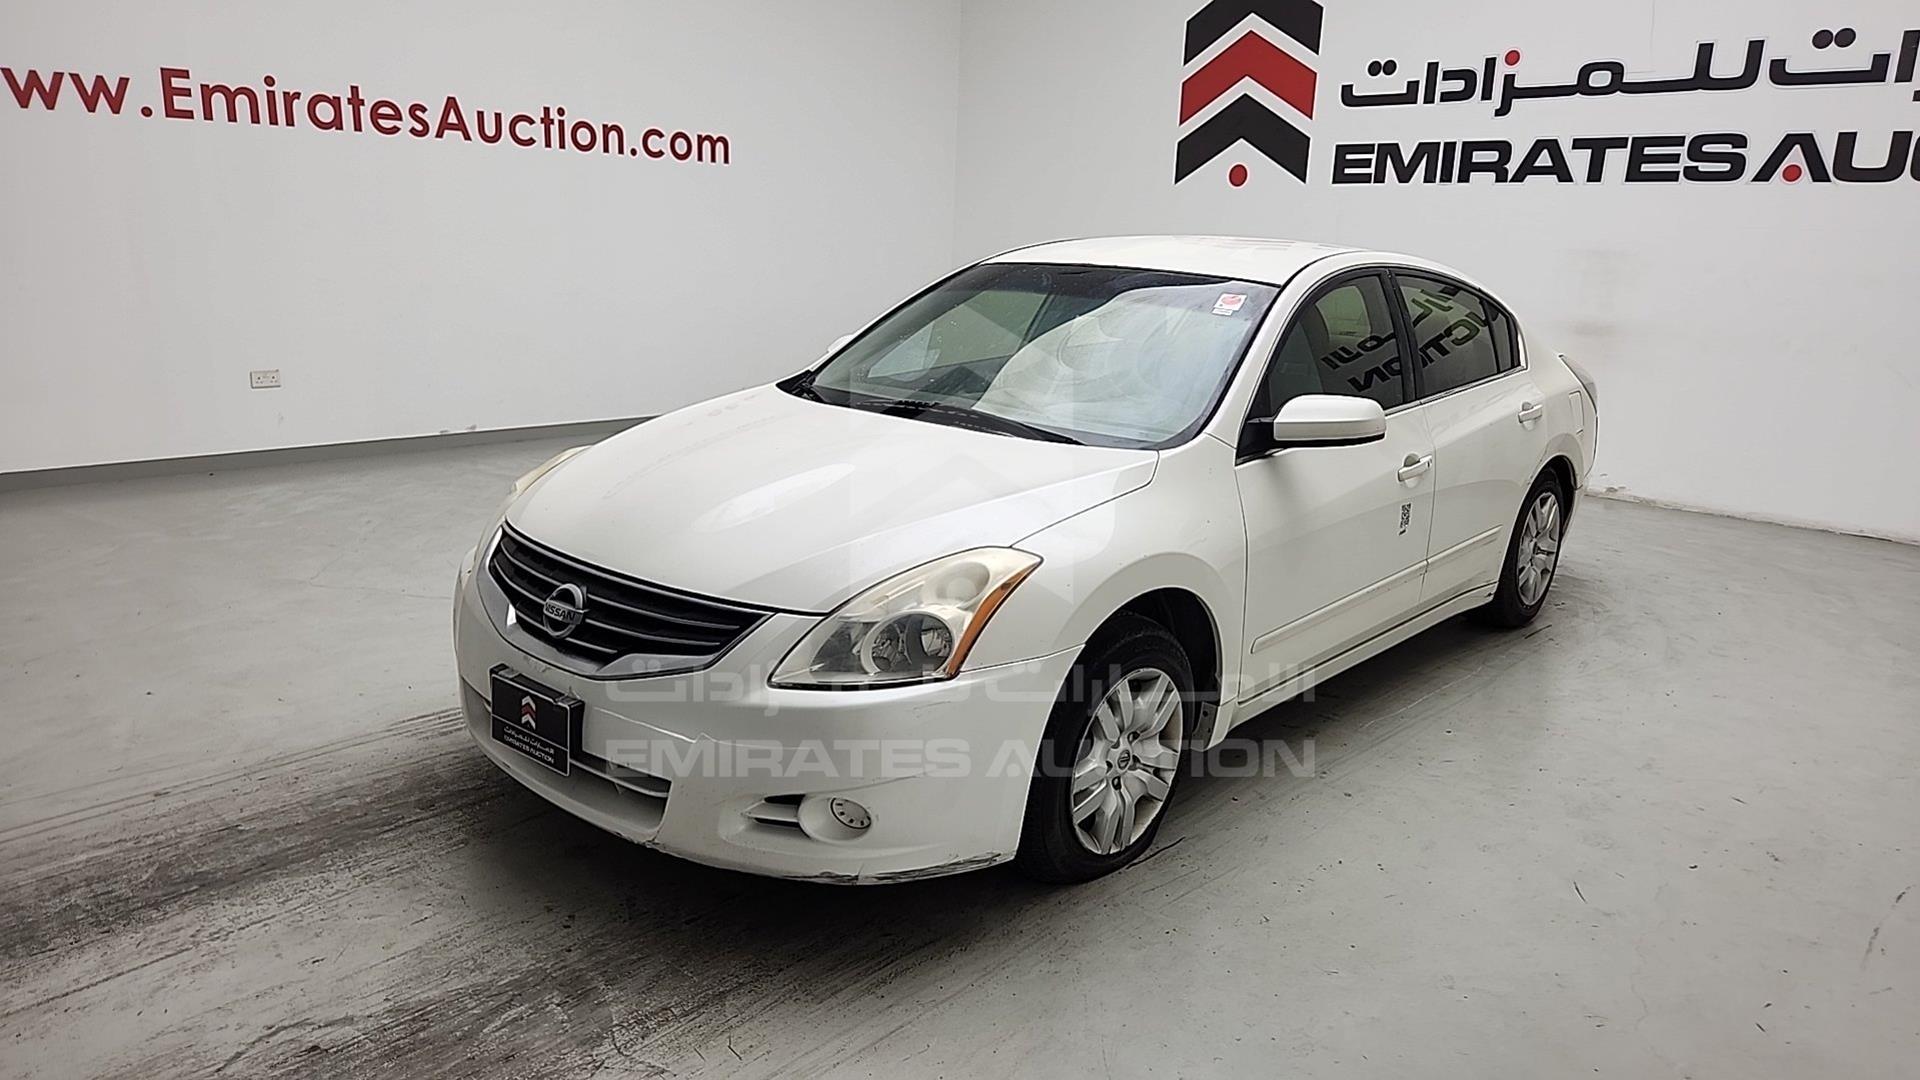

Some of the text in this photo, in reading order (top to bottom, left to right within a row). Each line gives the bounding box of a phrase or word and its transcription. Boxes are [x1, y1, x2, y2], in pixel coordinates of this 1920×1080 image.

[1341, 40, 1765, 117] للمزادات
[1332, 131, 1920, 184] EMIRATES AU
